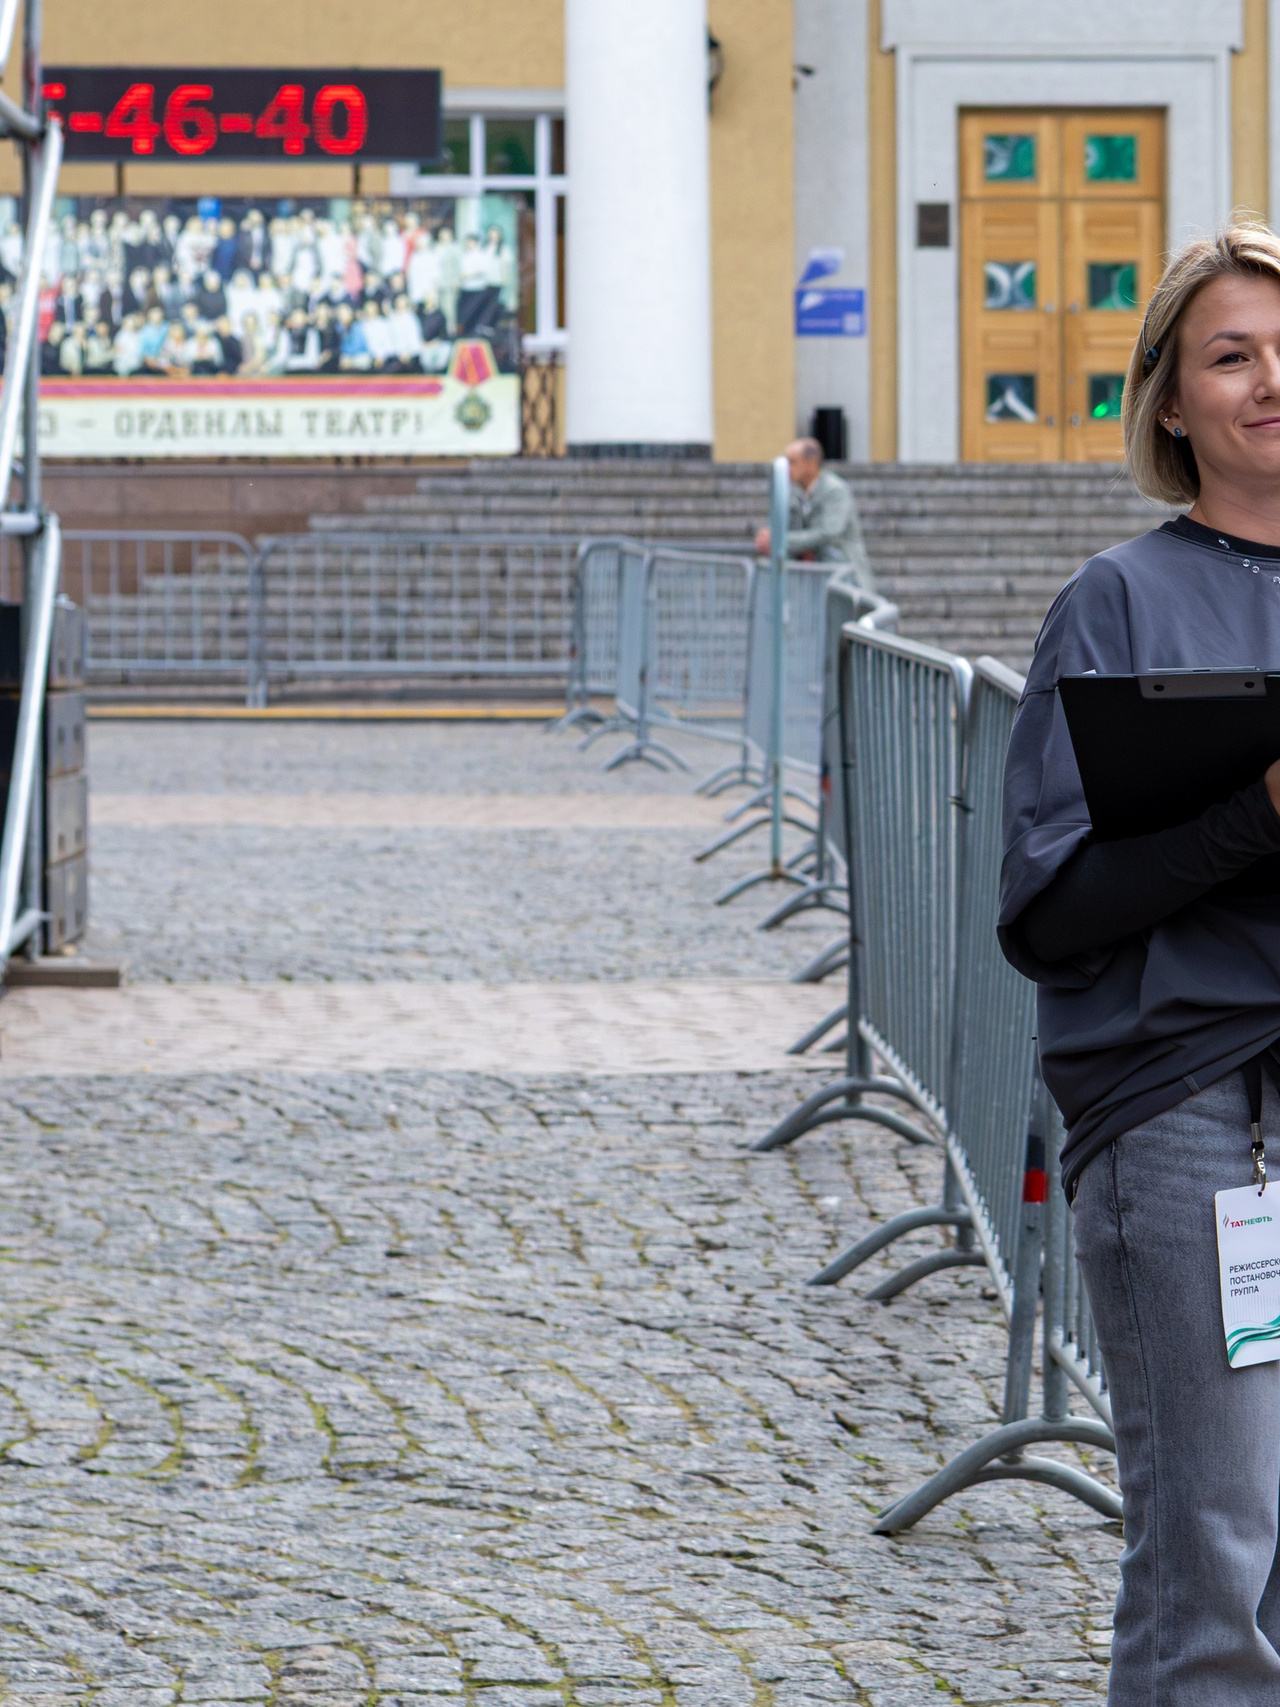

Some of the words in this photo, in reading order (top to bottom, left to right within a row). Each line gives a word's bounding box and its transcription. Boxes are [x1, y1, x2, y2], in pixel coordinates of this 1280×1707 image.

[114, 408, 283, 440] ОРДЕНЛЫ
[301, 408, 424, 438] ТЕАТР!
[1230, 1216, 1273, 1228] ТАТНЕФТЬ
[1230, 1285, 1259, 1298] ГРУППА
